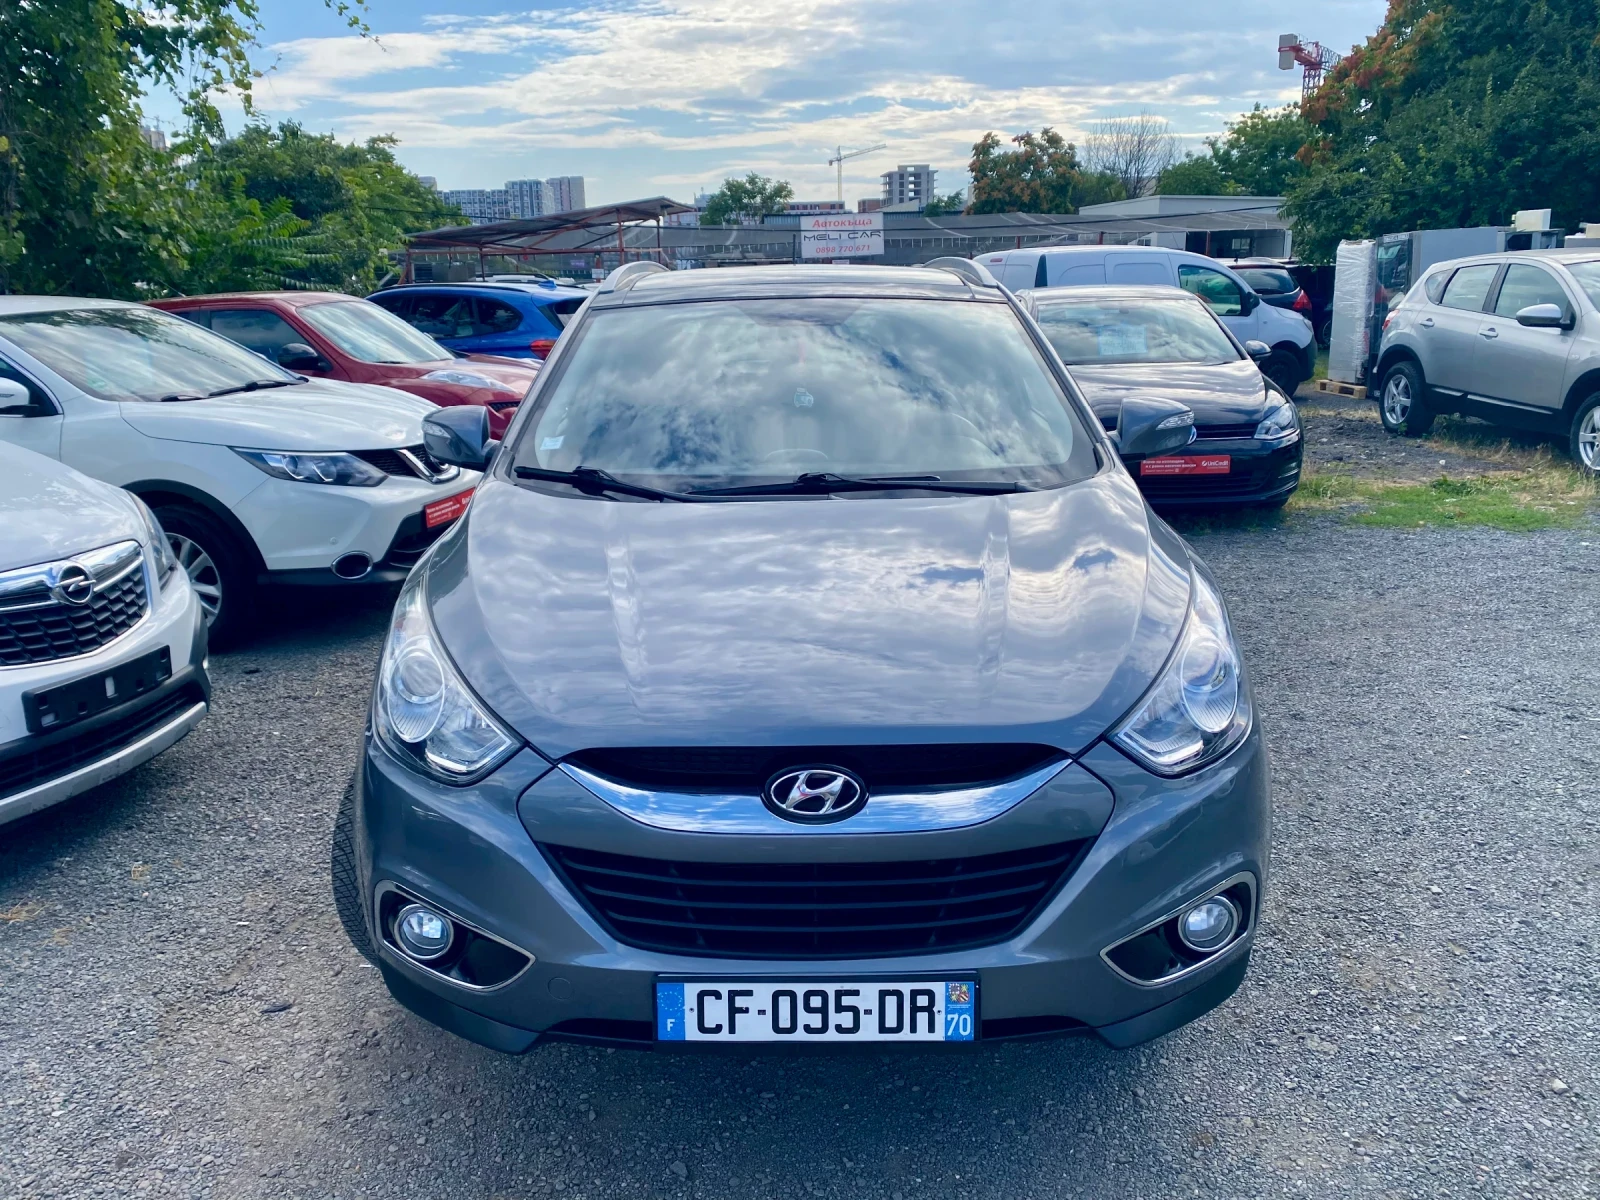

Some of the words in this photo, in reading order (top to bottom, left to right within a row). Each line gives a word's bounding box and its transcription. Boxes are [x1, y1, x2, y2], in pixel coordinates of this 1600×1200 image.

[812, 218, 872, 228] Автокъща
[803, 233, 841, 242] MELI
[847, 231, 881, 239] CAR
[815, 246, 836, 254] 0898
[855, 244, 870, 252] 671
[666, 1018, 675, 1032] F
[696, 988, 936, 1035] CF-095-DR
[947, 1012, 971, 1036] 70
